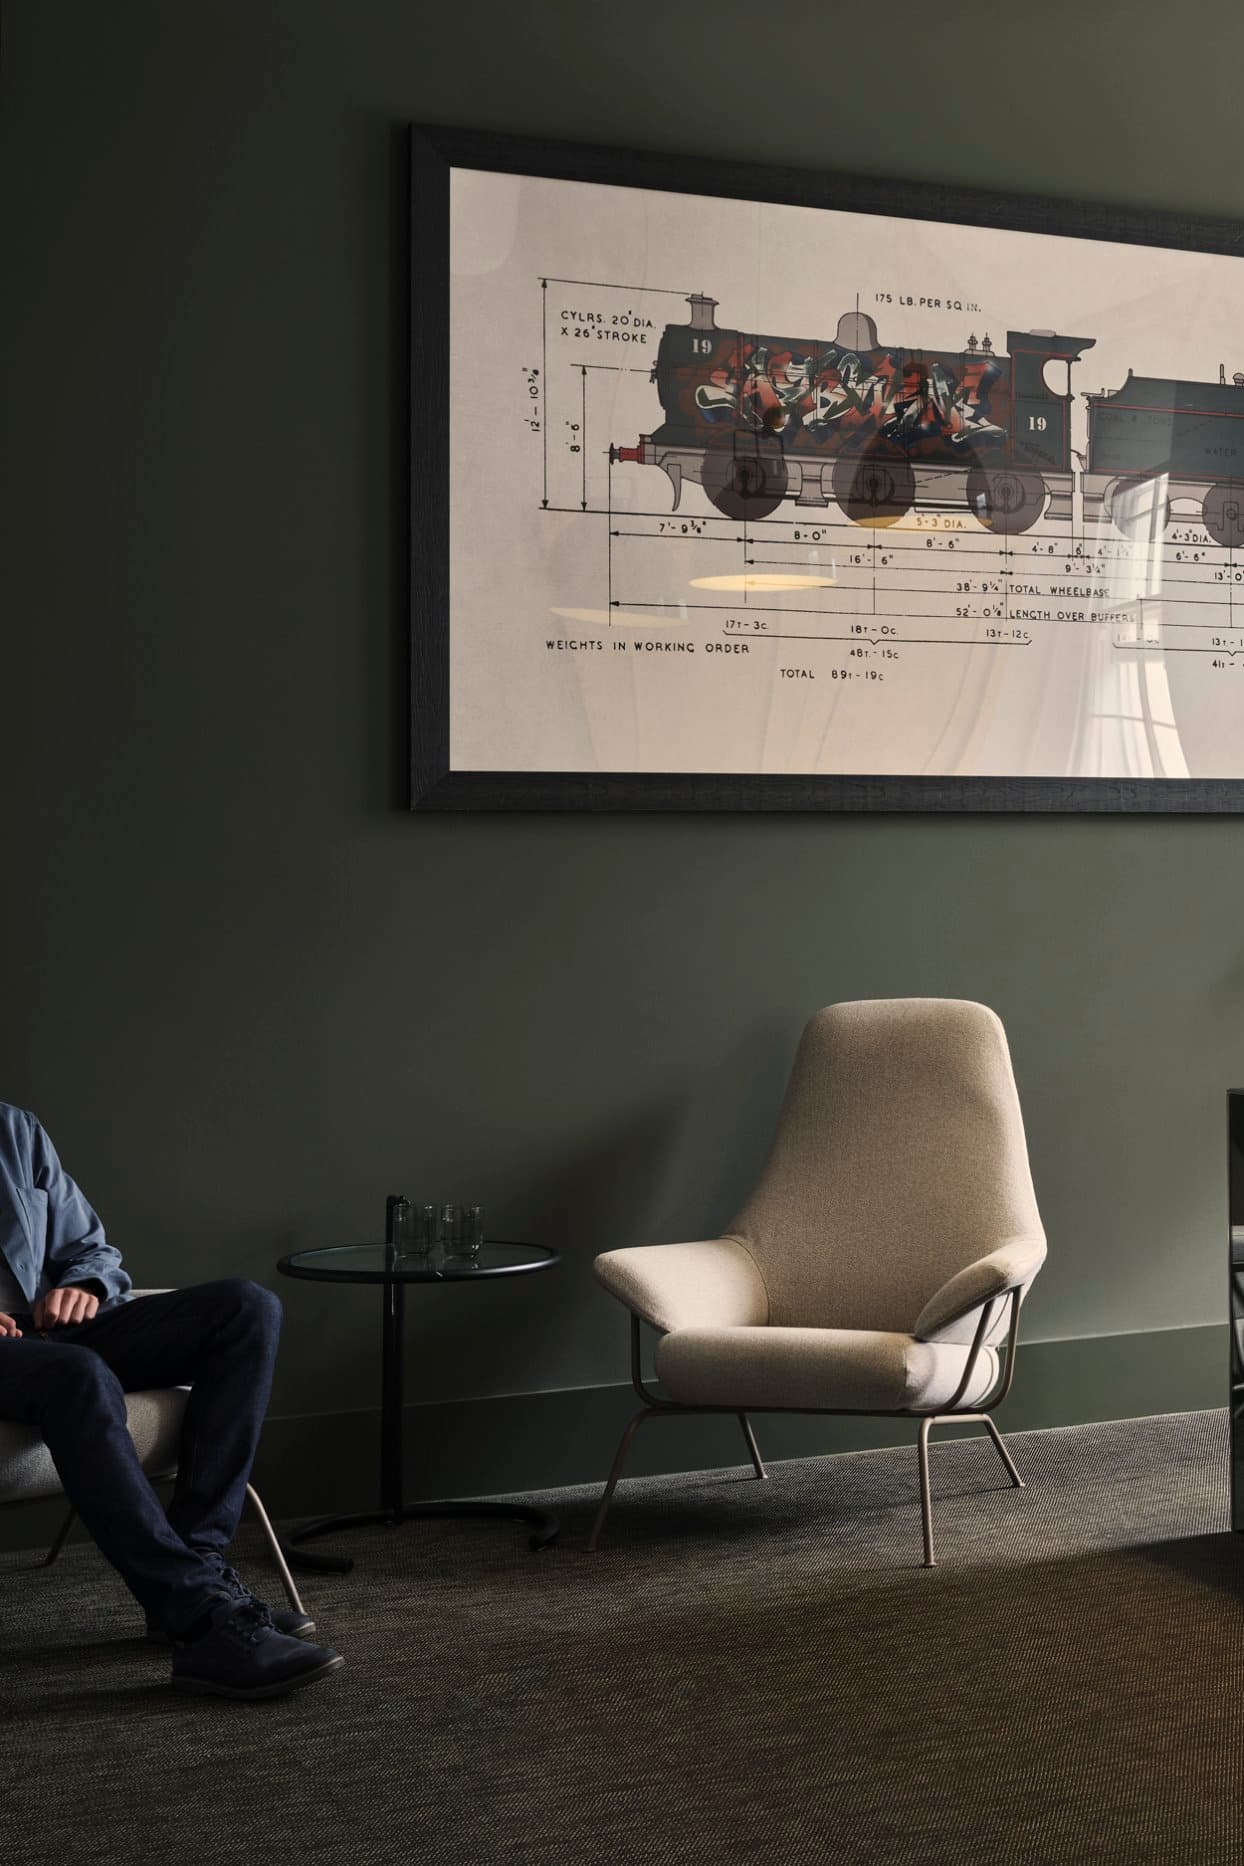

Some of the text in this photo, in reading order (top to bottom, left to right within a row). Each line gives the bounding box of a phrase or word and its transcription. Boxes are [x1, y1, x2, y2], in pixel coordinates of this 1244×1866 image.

[875, 293, 893, 303] 175
[919, 297, 941, 308] PER
[560, 310, 606, 324] CYLRS.
[560, 326, 568, 336] X
[692, 338, 712, 354] 19
[1028, 415, 1047, 431] 19
[1009, 584, 1041, 594] TOTAL
[1009, 609, 1051, 619] LENGTH
[1056, 611, 1085, 621] OVER
[545, 640, 751, 654] WEIGHTS IN WORKING ORDER
[779, 668, 815, 679] TOTAL
